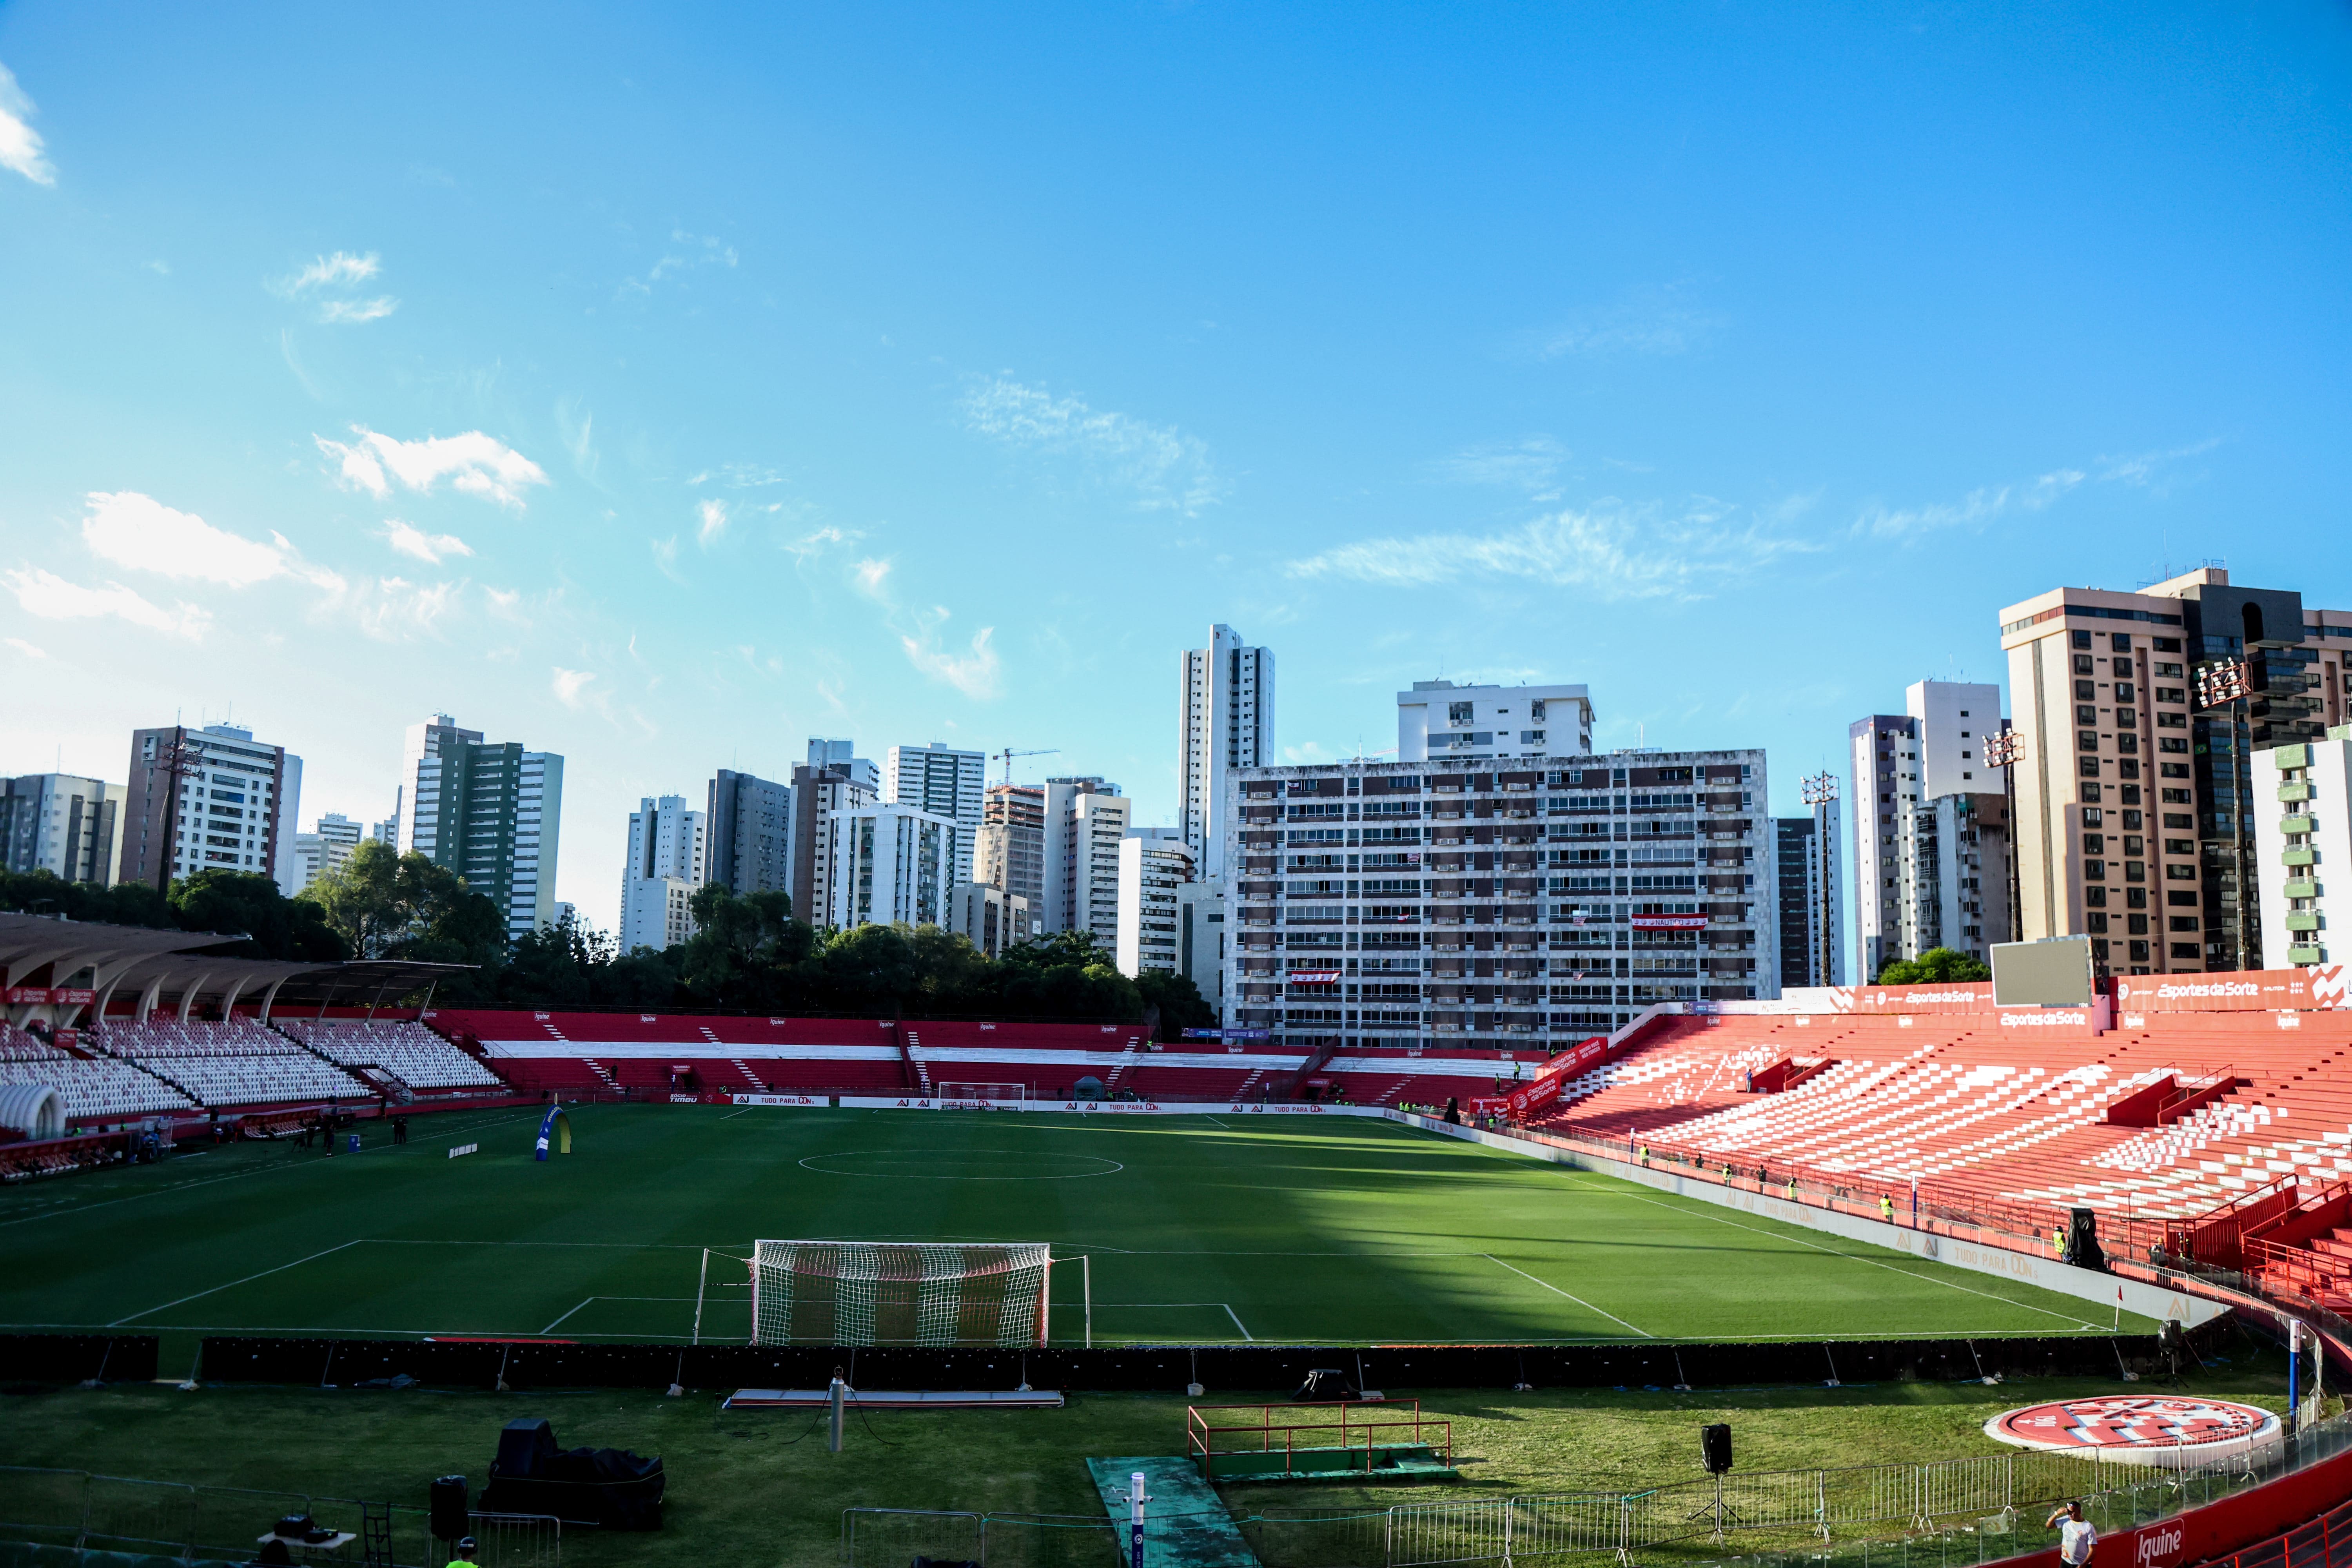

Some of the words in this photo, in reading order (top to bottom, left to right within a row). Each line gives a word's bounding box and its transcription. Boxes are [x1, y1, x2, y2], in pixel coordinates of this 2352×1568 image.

[1906, 992, 1942, 1005] Esportes
[1952, 991, 1975, 1002] Sorte
[2158, 984, 2210, 1000] Esportes
[2210, 983, 2225, 996] da
[2225, 982, 2258, 996] Sorte
[2001, 1013, 2043, 1028] Esportes
[2056, 1011, 2085, 1025] Sorte
[1501, 1052, 1513, 1060] Iquine
[1527, 1077, 1556, 1096] Esportes
[1539, 1085, 1557, 1099] Sorte
[1765, 1201, 1779, 1215] TUDO
[1781, 1206, 1797, 1220] PARA
[1955, 1247, 1977, 1265] TUDO
[1982, 1253, 2007, 1271] PARA
[2138, 1528, 2182, 1568] Iquine
